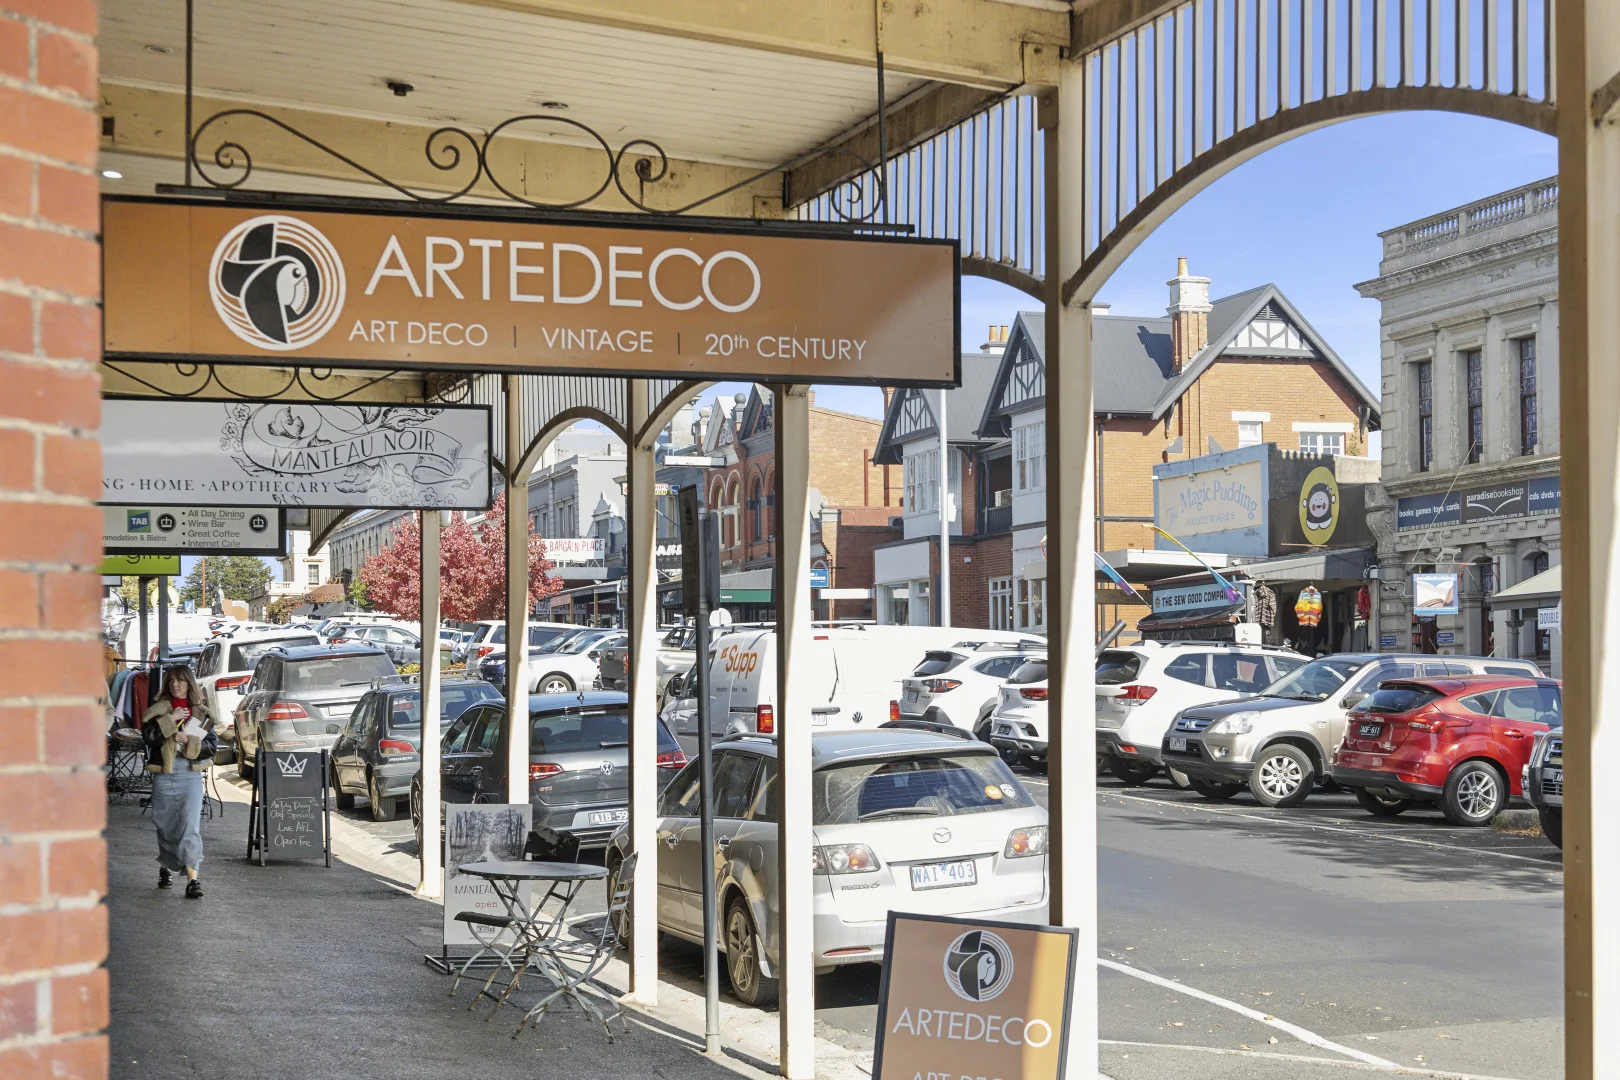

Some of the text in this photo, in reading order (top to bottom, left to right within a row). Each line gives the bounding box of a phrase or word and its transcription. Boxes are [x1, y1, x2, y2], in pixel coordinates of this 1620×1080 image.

[364, 234, 761, 314] ARTEDECO
[348, 320, 867, 361] ART DECO VINTAGE 20th CENTURY
[272, 430, 435, 471] MANTEAU NOIR
[139, 478, 195, 491] HOME
[208, 479, 331, 493] APOTHECARY
[1180, 482, 1212, 513] Magic
[1213, 480, 1258, 520] Pudding
[1466, 487, 1524, 502] paradisebookshop
[1529, 491, 1540, 501] cds
[1540, 489, 1555, 500] dvds
[188, 510, 245, 520] All Day Dining
[1398, 509, 1414, 518] books
[1415, 507, 1432, 518] games
[1446, 502, 1460, 512] cards
[131, 517, 148, 526] TAB
[188, 520, 226, 528] Wine Bar
[147, 534, 167, 542] Bistro
[188, 530, 240, 538] Great Coffee
[188, 540, 241, 548] Internet Cafe
[582, 539, 603, 552] PLACE
[1162, 596, 1173, 607] THE
[1173, 594, 1187, 606] SEW
[1188, 592, 1203, 605] GOOD
[1204, 589, 1228, 603] COMPAN
[295, 821, 314, 833] AFL
[949, 863, 974, 880] 403
[475, 901, 499, 909] open
[892, 1007, 1053, 1048] ARTEDECO
